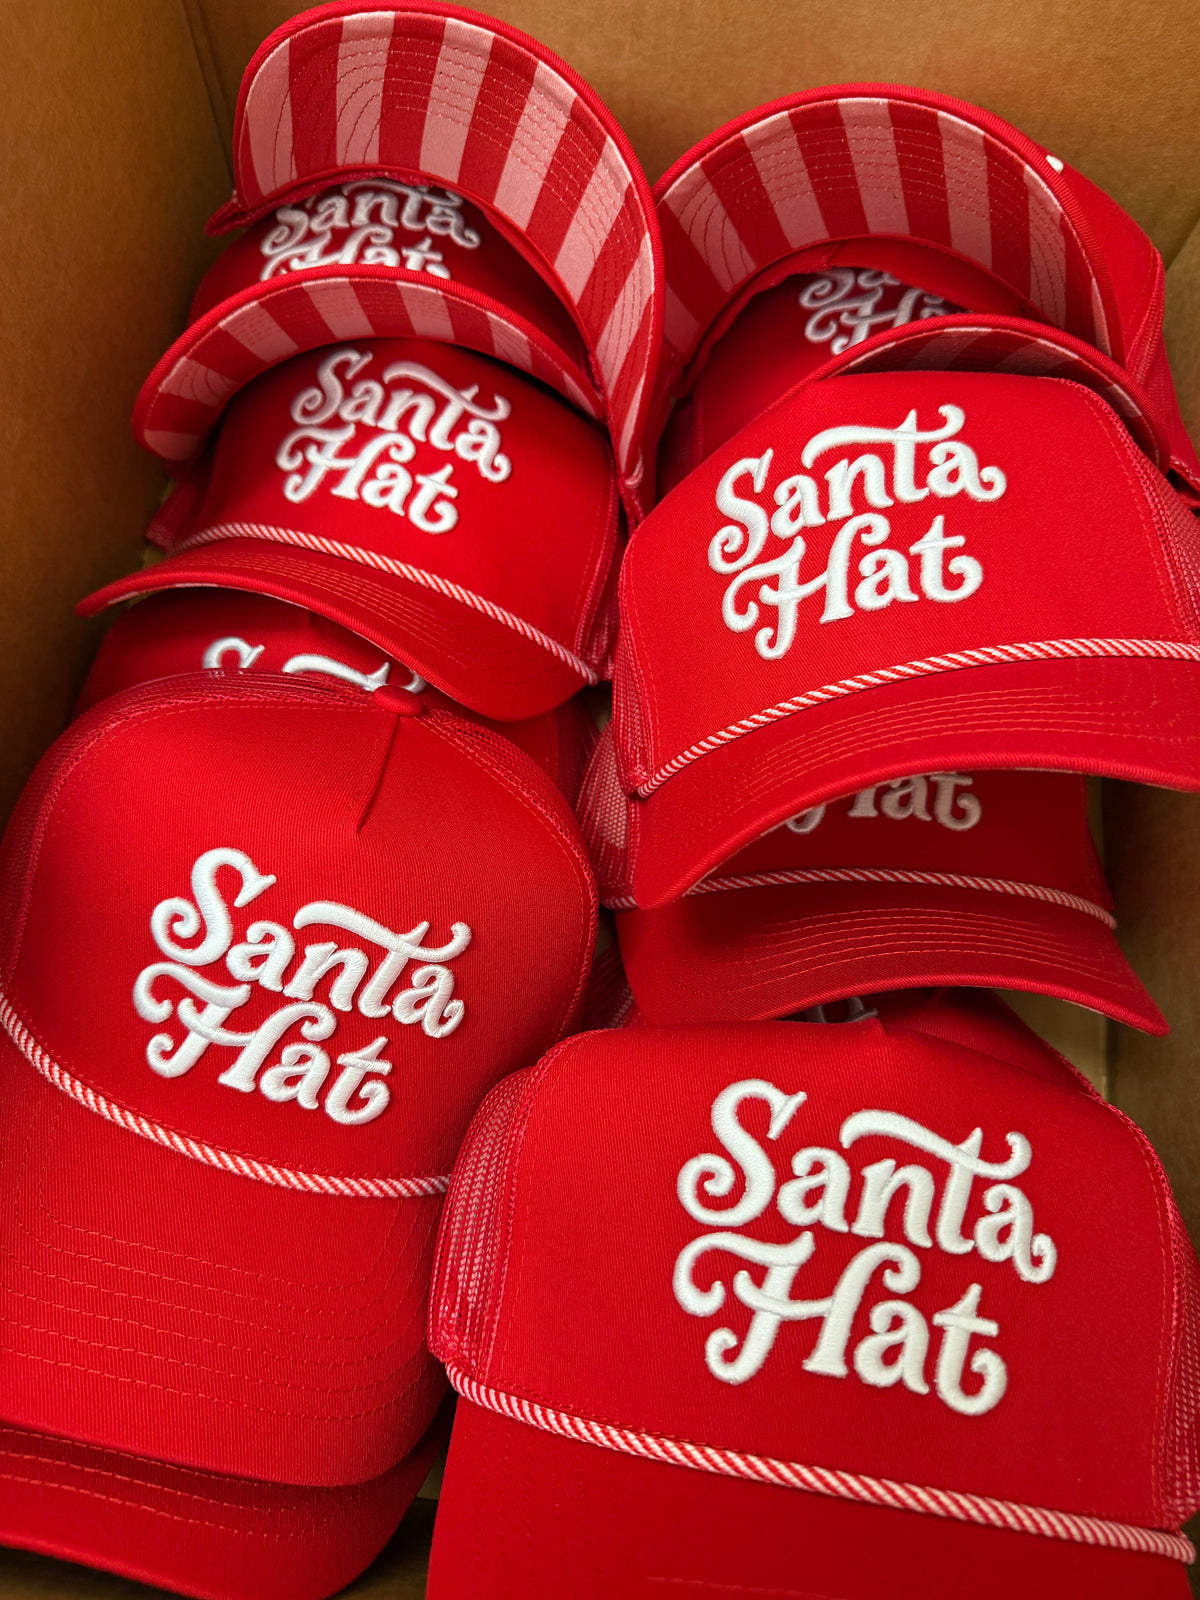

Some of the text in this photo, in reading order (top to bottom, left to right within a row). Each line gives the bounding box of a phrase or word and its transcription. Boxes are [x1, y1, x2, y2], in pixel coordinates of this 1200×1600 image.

[276, 424, 459, 535] Hat
[291, 348, 512, 483] Santa
[708, 403, 1007, 575] Santa
[722, 512, 984, 661] Hat
[150, 847, 472, 1039] Santa
[133, 961, 393, 1126] Hat
[676, 1078, 1058, 1284] Santa
[672, 1230, 1008, 1416] Hat
